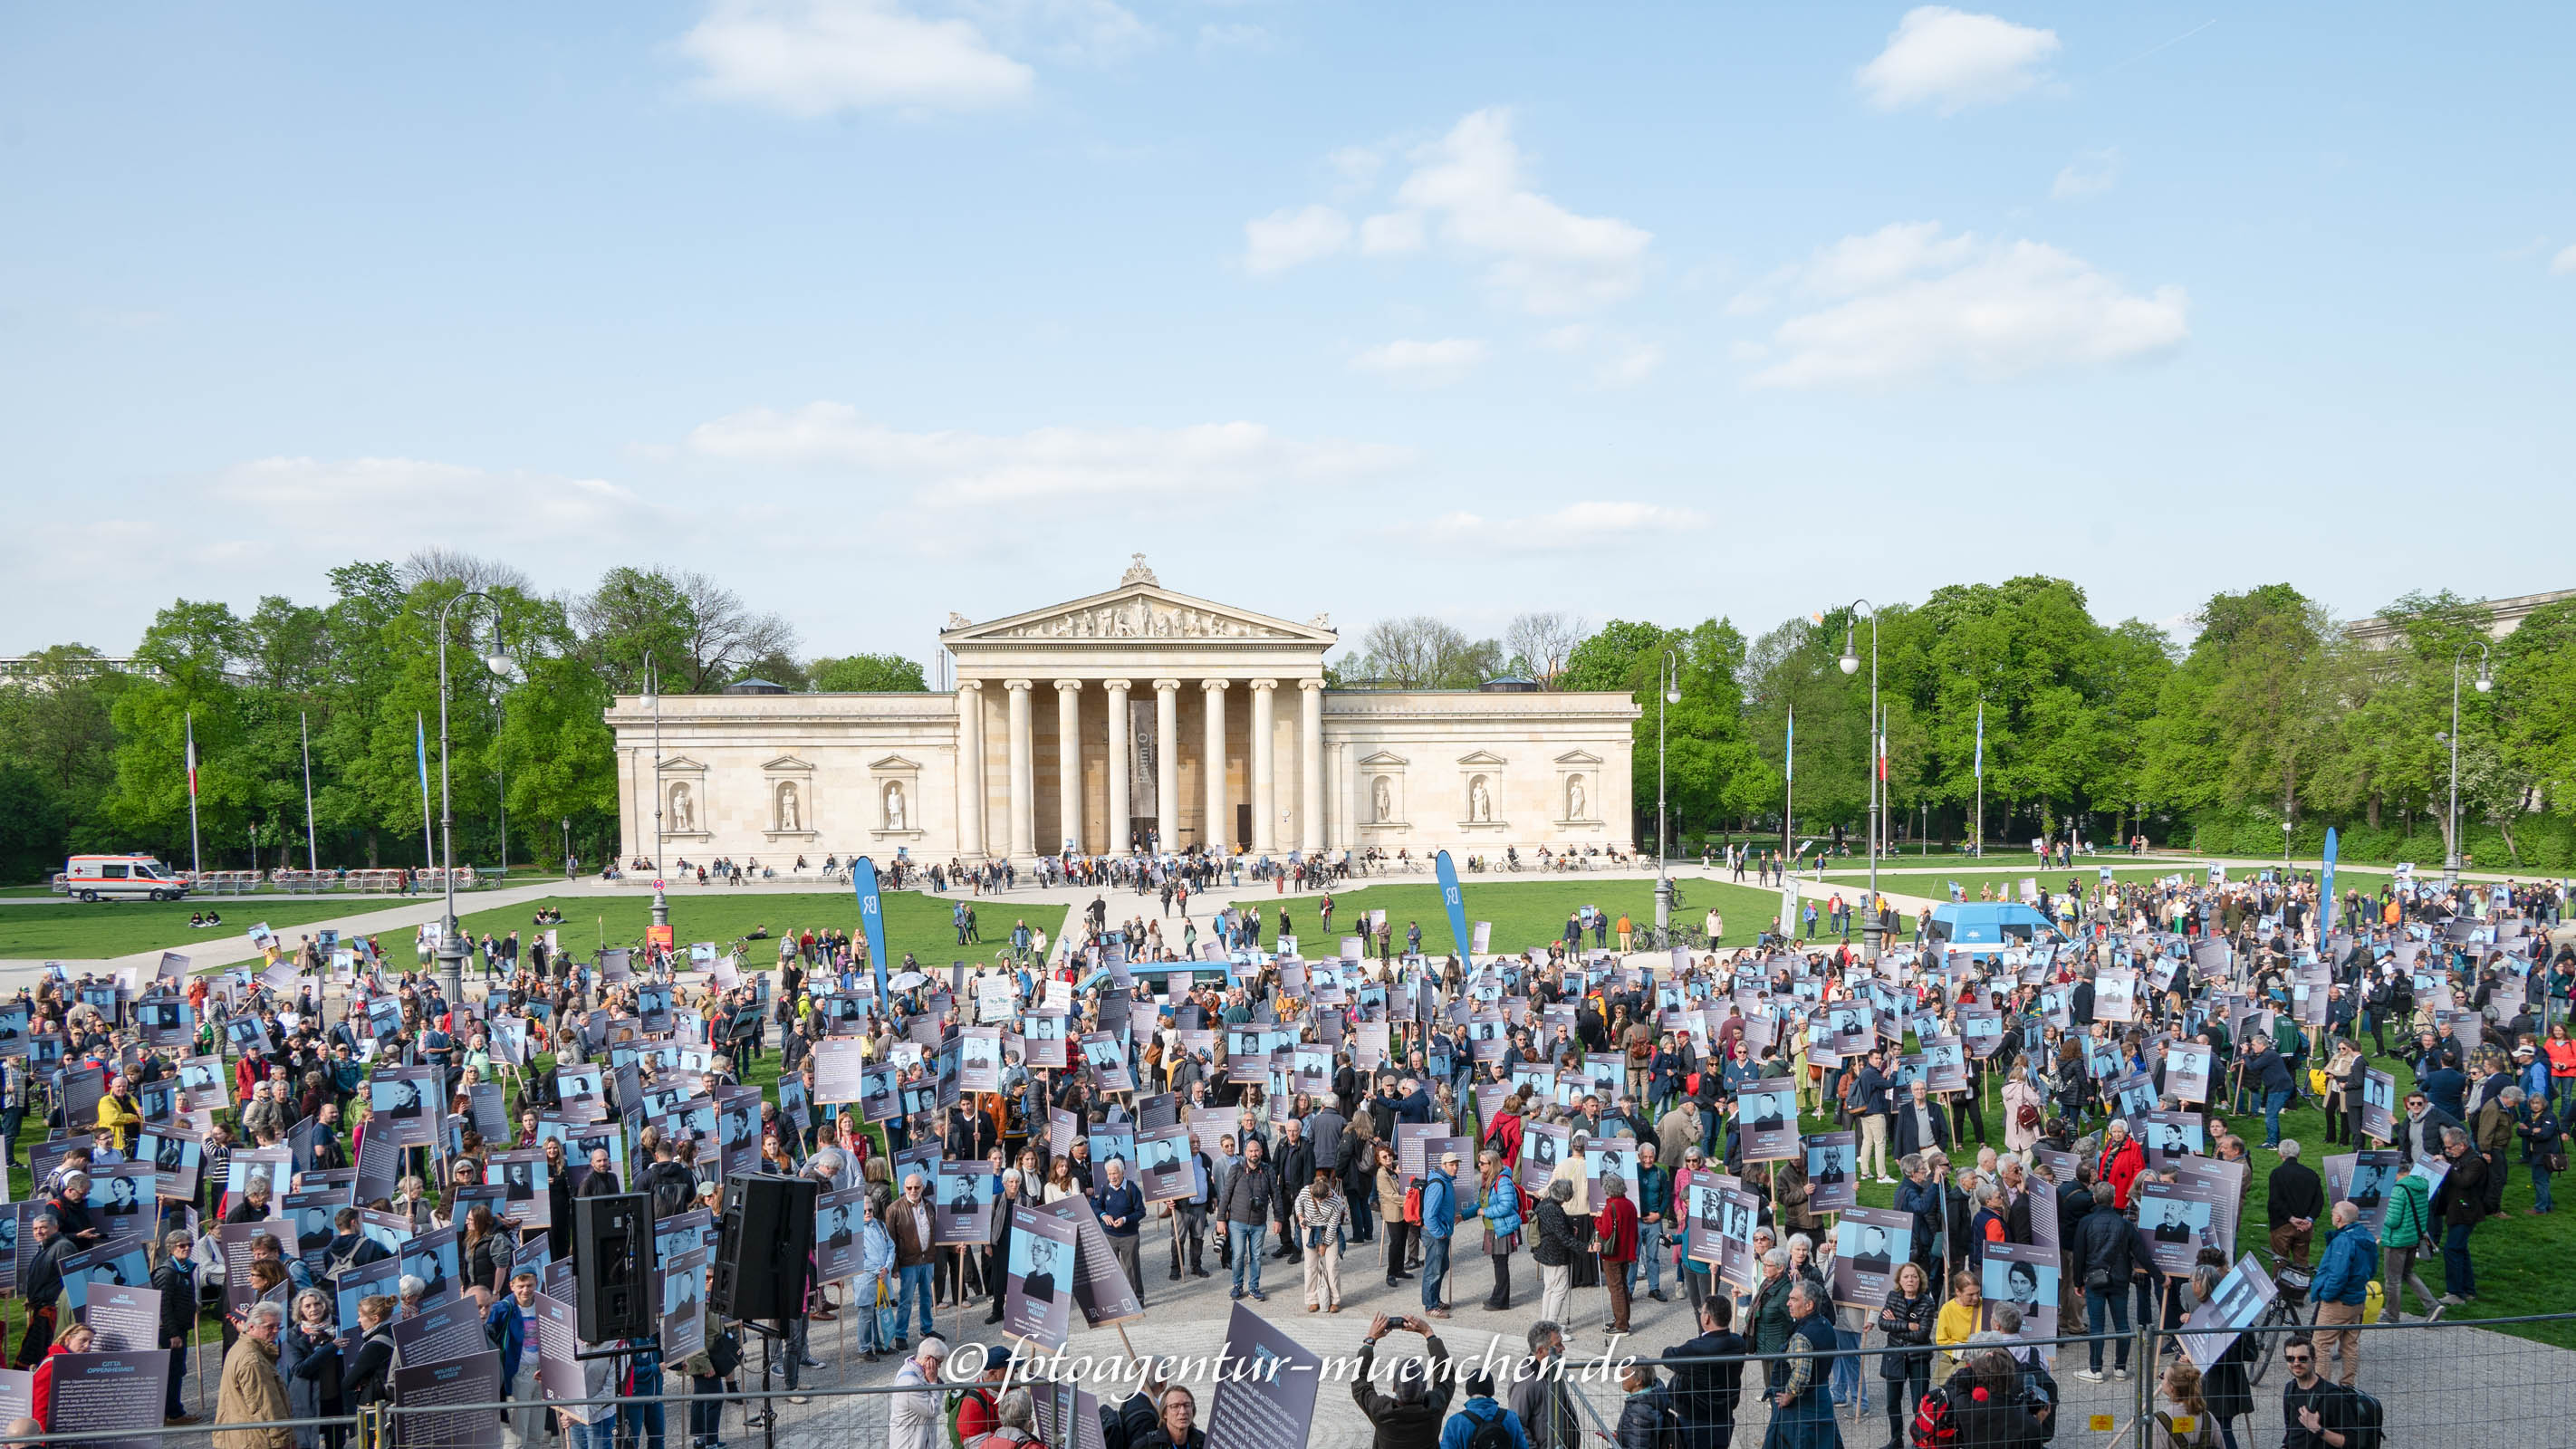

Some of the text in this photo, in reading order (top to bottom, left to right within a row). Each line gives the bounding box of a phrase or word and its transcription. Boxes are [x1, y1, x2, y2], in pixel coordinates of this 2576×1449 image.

[87, 1366, 136, 1374] OPPENHEIMER
[434, 1365, 463, 1376] WILHELM
[437, 1371, 458, 1380] KAISER
